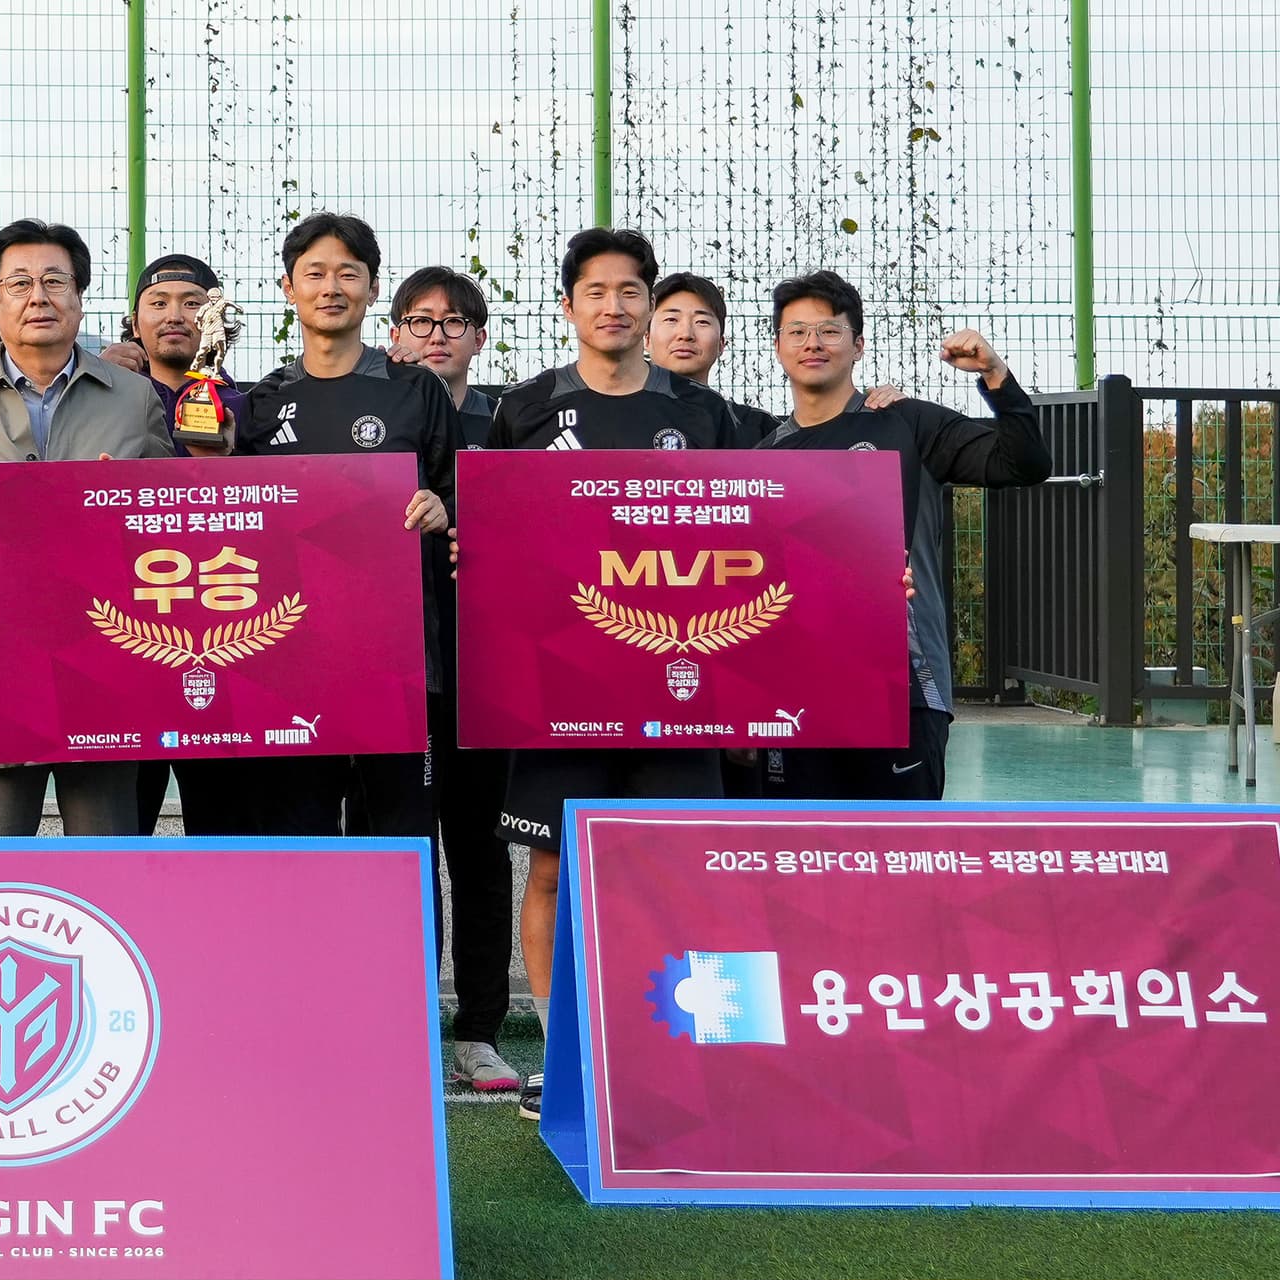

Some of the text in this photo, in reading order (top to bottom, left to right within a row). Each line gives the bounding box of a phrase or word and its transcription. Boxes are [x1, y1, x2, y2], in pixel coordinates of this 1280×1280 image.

[277, 402, 297, 420] 42
[558, 409, 577, 428] 10
[83, 485, 299, 507] 2025 용인FC와 함께하는
[571, 479, 785, 498] 2025 용인FC와 함께하는
[124, 511, 264, 534] 직장인 풋살대회
[611, 505, 751, 525] 직장인 풋살대회
[598, 550, 764, 586] MVP
[133, 546, 260, 614] 우승
[549, 721, 624, 732] YONGIN FC
[662, 724, 735, 736] 용인상공회의소
[748, 722, 794, 737] PUMA
[67, 733, 142, 745] YONGIN FC
[180, 733, 253, 746] 용인상공회의소
[264, 729, 311, 745] PUMA
[501, 811, 552, 838] OYOTA
[704, 850, 1170, 875] 2025 용인FC와 함께하는 직장인 풋살대회
[800, 968, 1268, 1037] 용인상공회의소
[109, 1010, 136, 1032] 26
[54, 1060, 122, 1125] CLUB
[93, 1200, 164, 1236] FC
[10, 1247, 54, 1258] CLUB
[69, 1247, 118, 1257] SINCE
[124, 1247, 165, 1257] 2026
